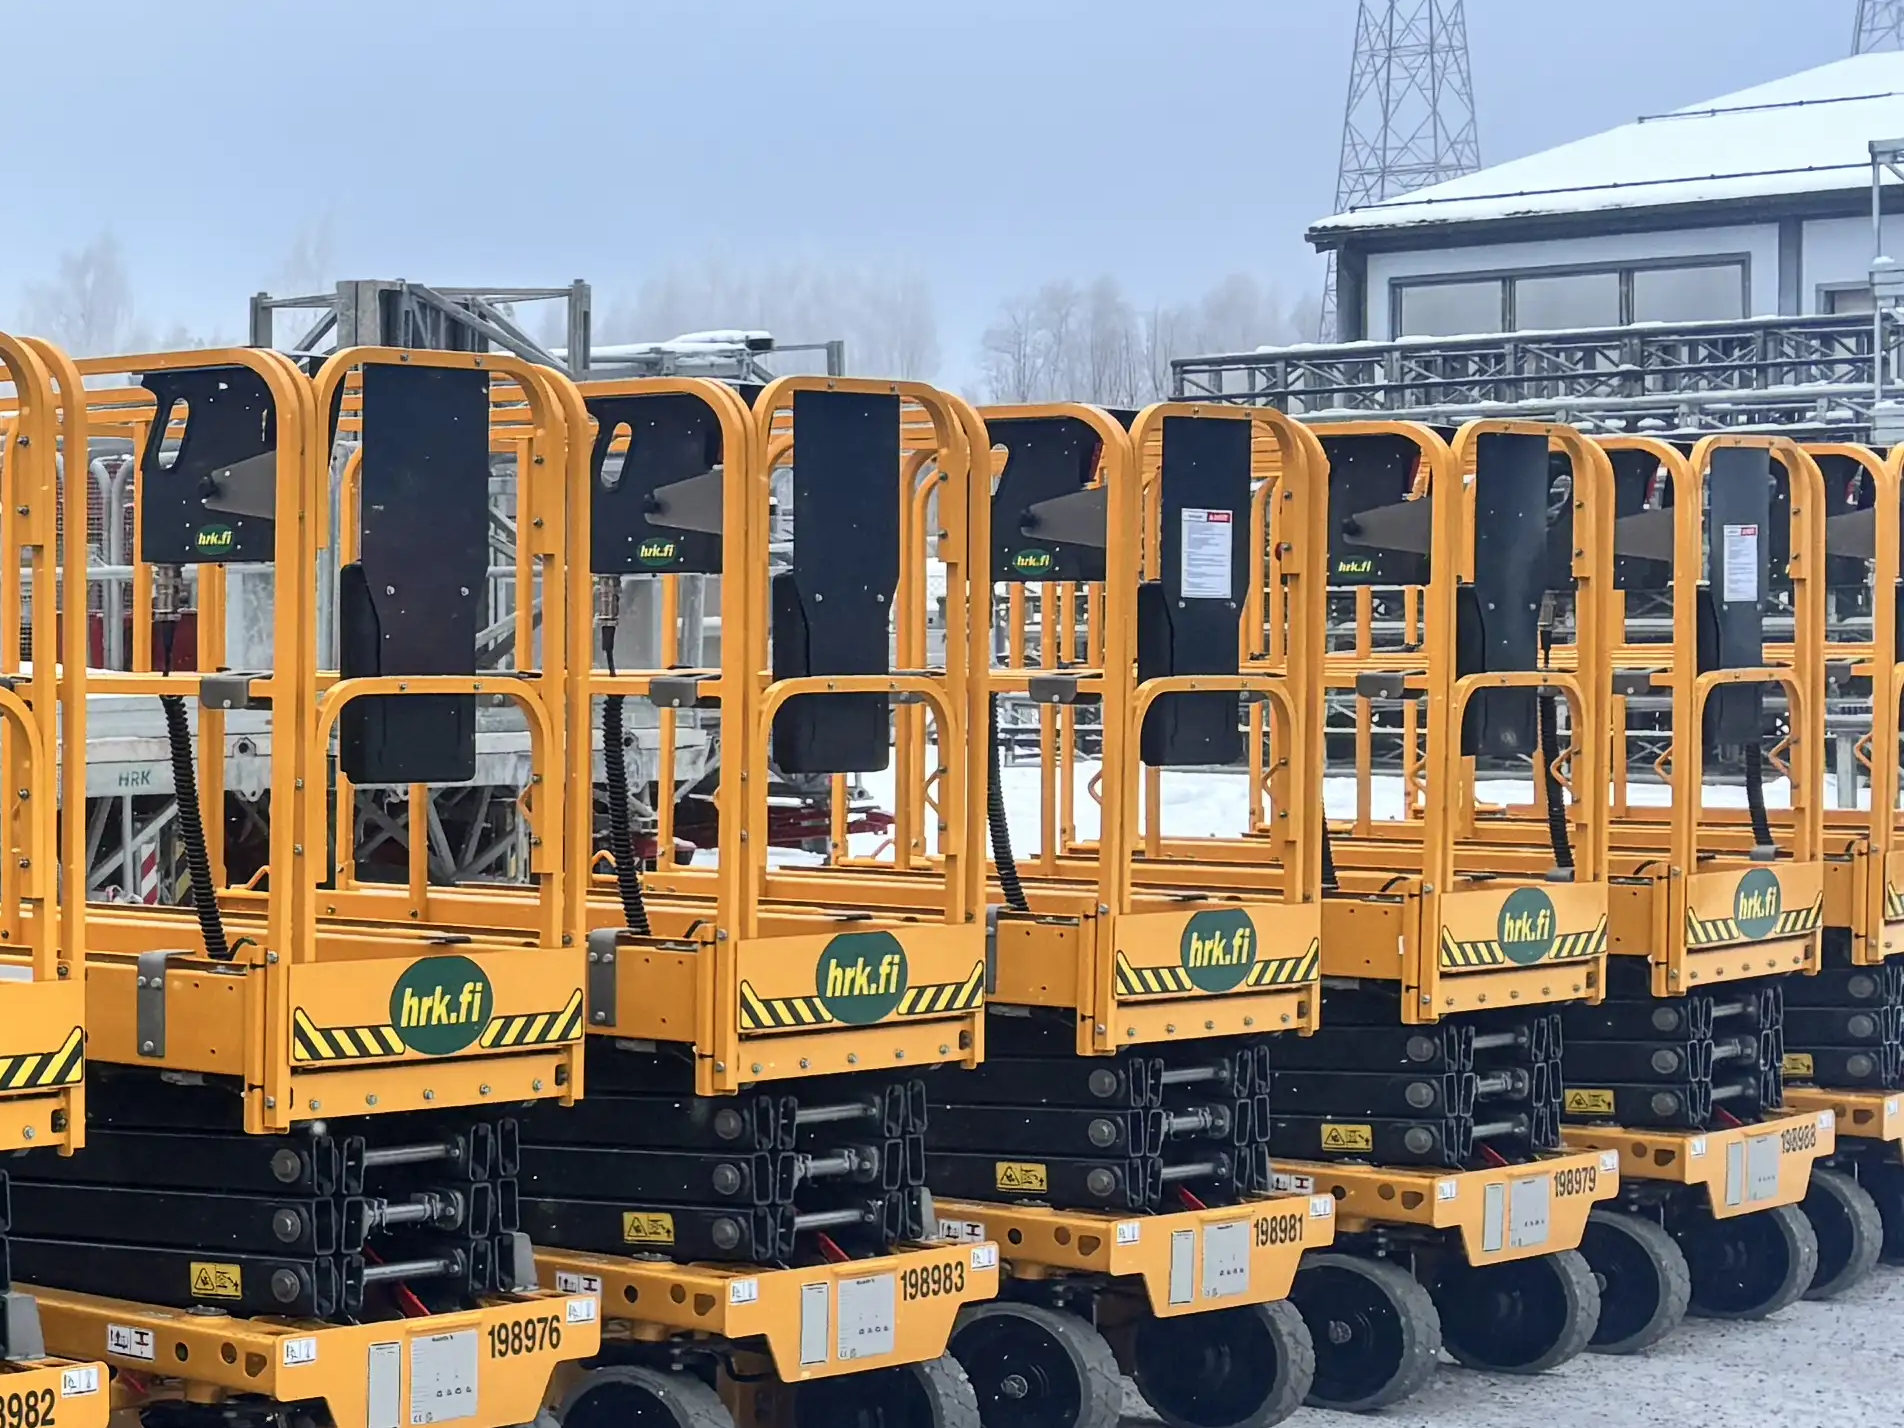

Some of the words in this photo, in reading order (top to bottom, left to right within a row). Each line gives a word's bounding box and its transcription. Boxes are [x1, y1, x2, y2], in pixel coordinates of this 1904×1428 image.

[198, 531, 232, 545] hrk.fi
[118, 769, 152, 787] HRK
[1738, 886, 1777, 921] hrk.fi
[1504, 908, 1551, 943] hrk.fi
[1188, 927, 1251, 968] hrk.fi
[825, 954, 901, 998] hrk.fi
[400, 981, 484, 1028] hrk.fi
[1554, 1165, 1597, 1198] 198979
[1253, 1213, 1304, 1247] 198981
[900, 1260, 965, 1301] 198983
[488, 1314, 562, 1359] 198976
